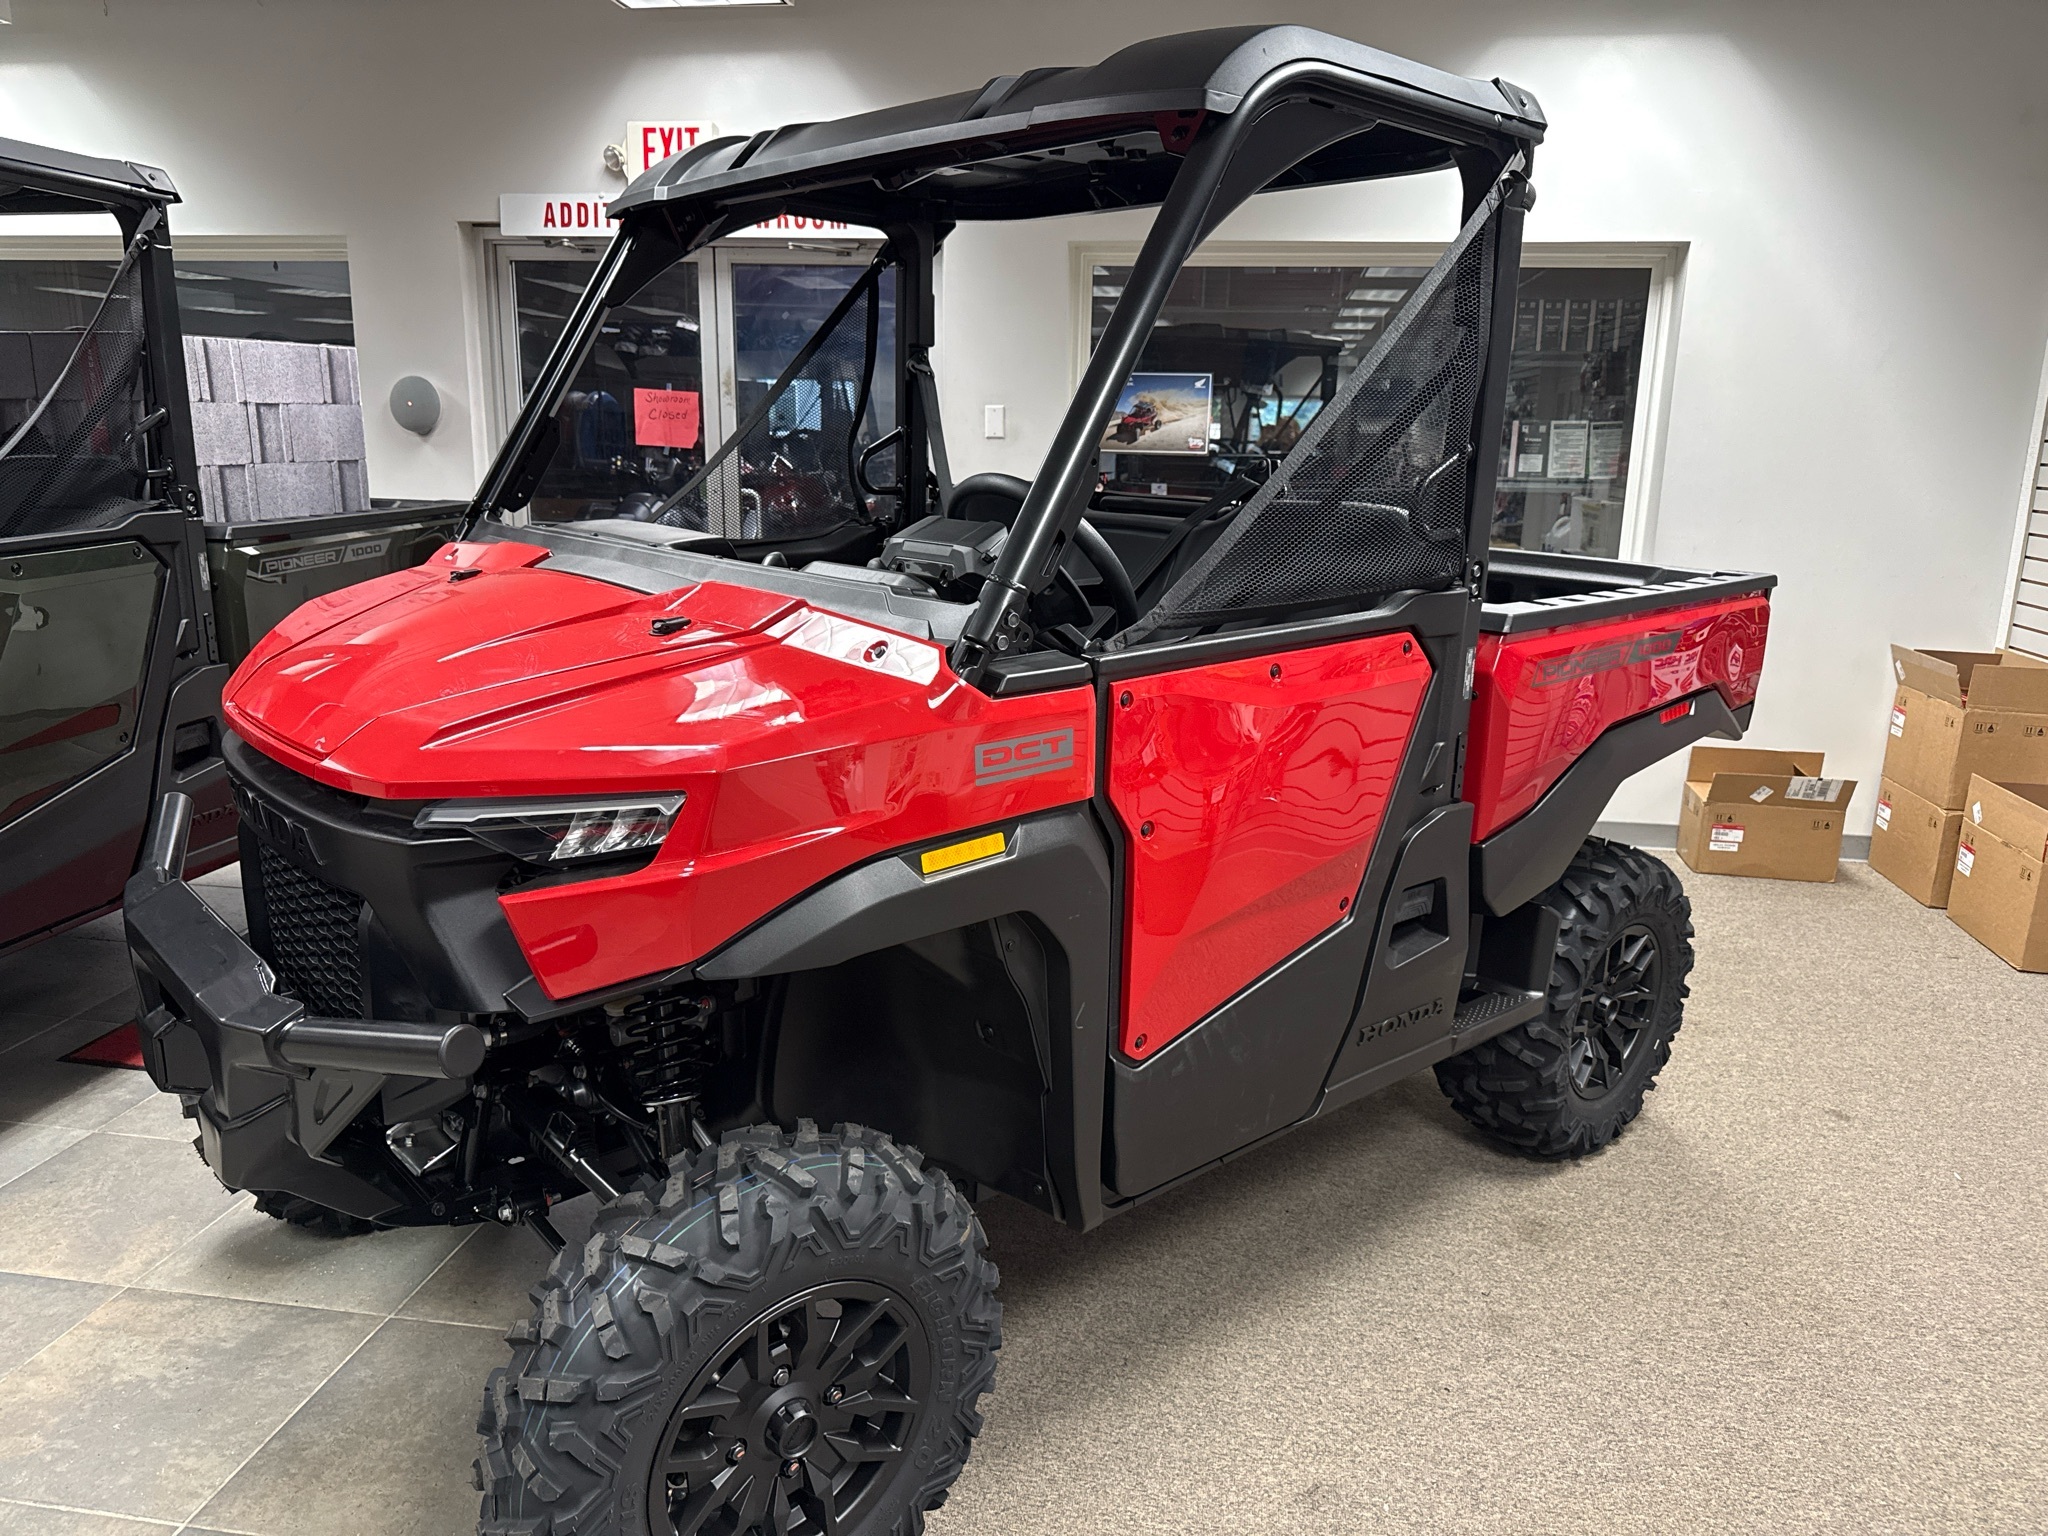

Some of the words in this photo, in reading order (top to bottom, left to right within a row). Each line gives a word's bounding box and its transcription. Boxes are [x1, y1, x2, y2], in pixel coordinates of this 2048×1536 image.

[544, 202, 624, 228] ADDIT
[644, 391, 692, 404] Showroom
[648, 408, 688, 420] Closed
[265, 551, 337, 573] PIONEER
[351, 544, 382, 557] 1000
[1543, 650, 1622, 681] PIONEER
[1638, 639, 1672, 657] 1000
[982, 735, 1067, 768] DCT
[192, 803, 237, 826] NDA
[227, 771, 327, 866] HONDA
[1356, 997, 1445, 1047] HONDA
